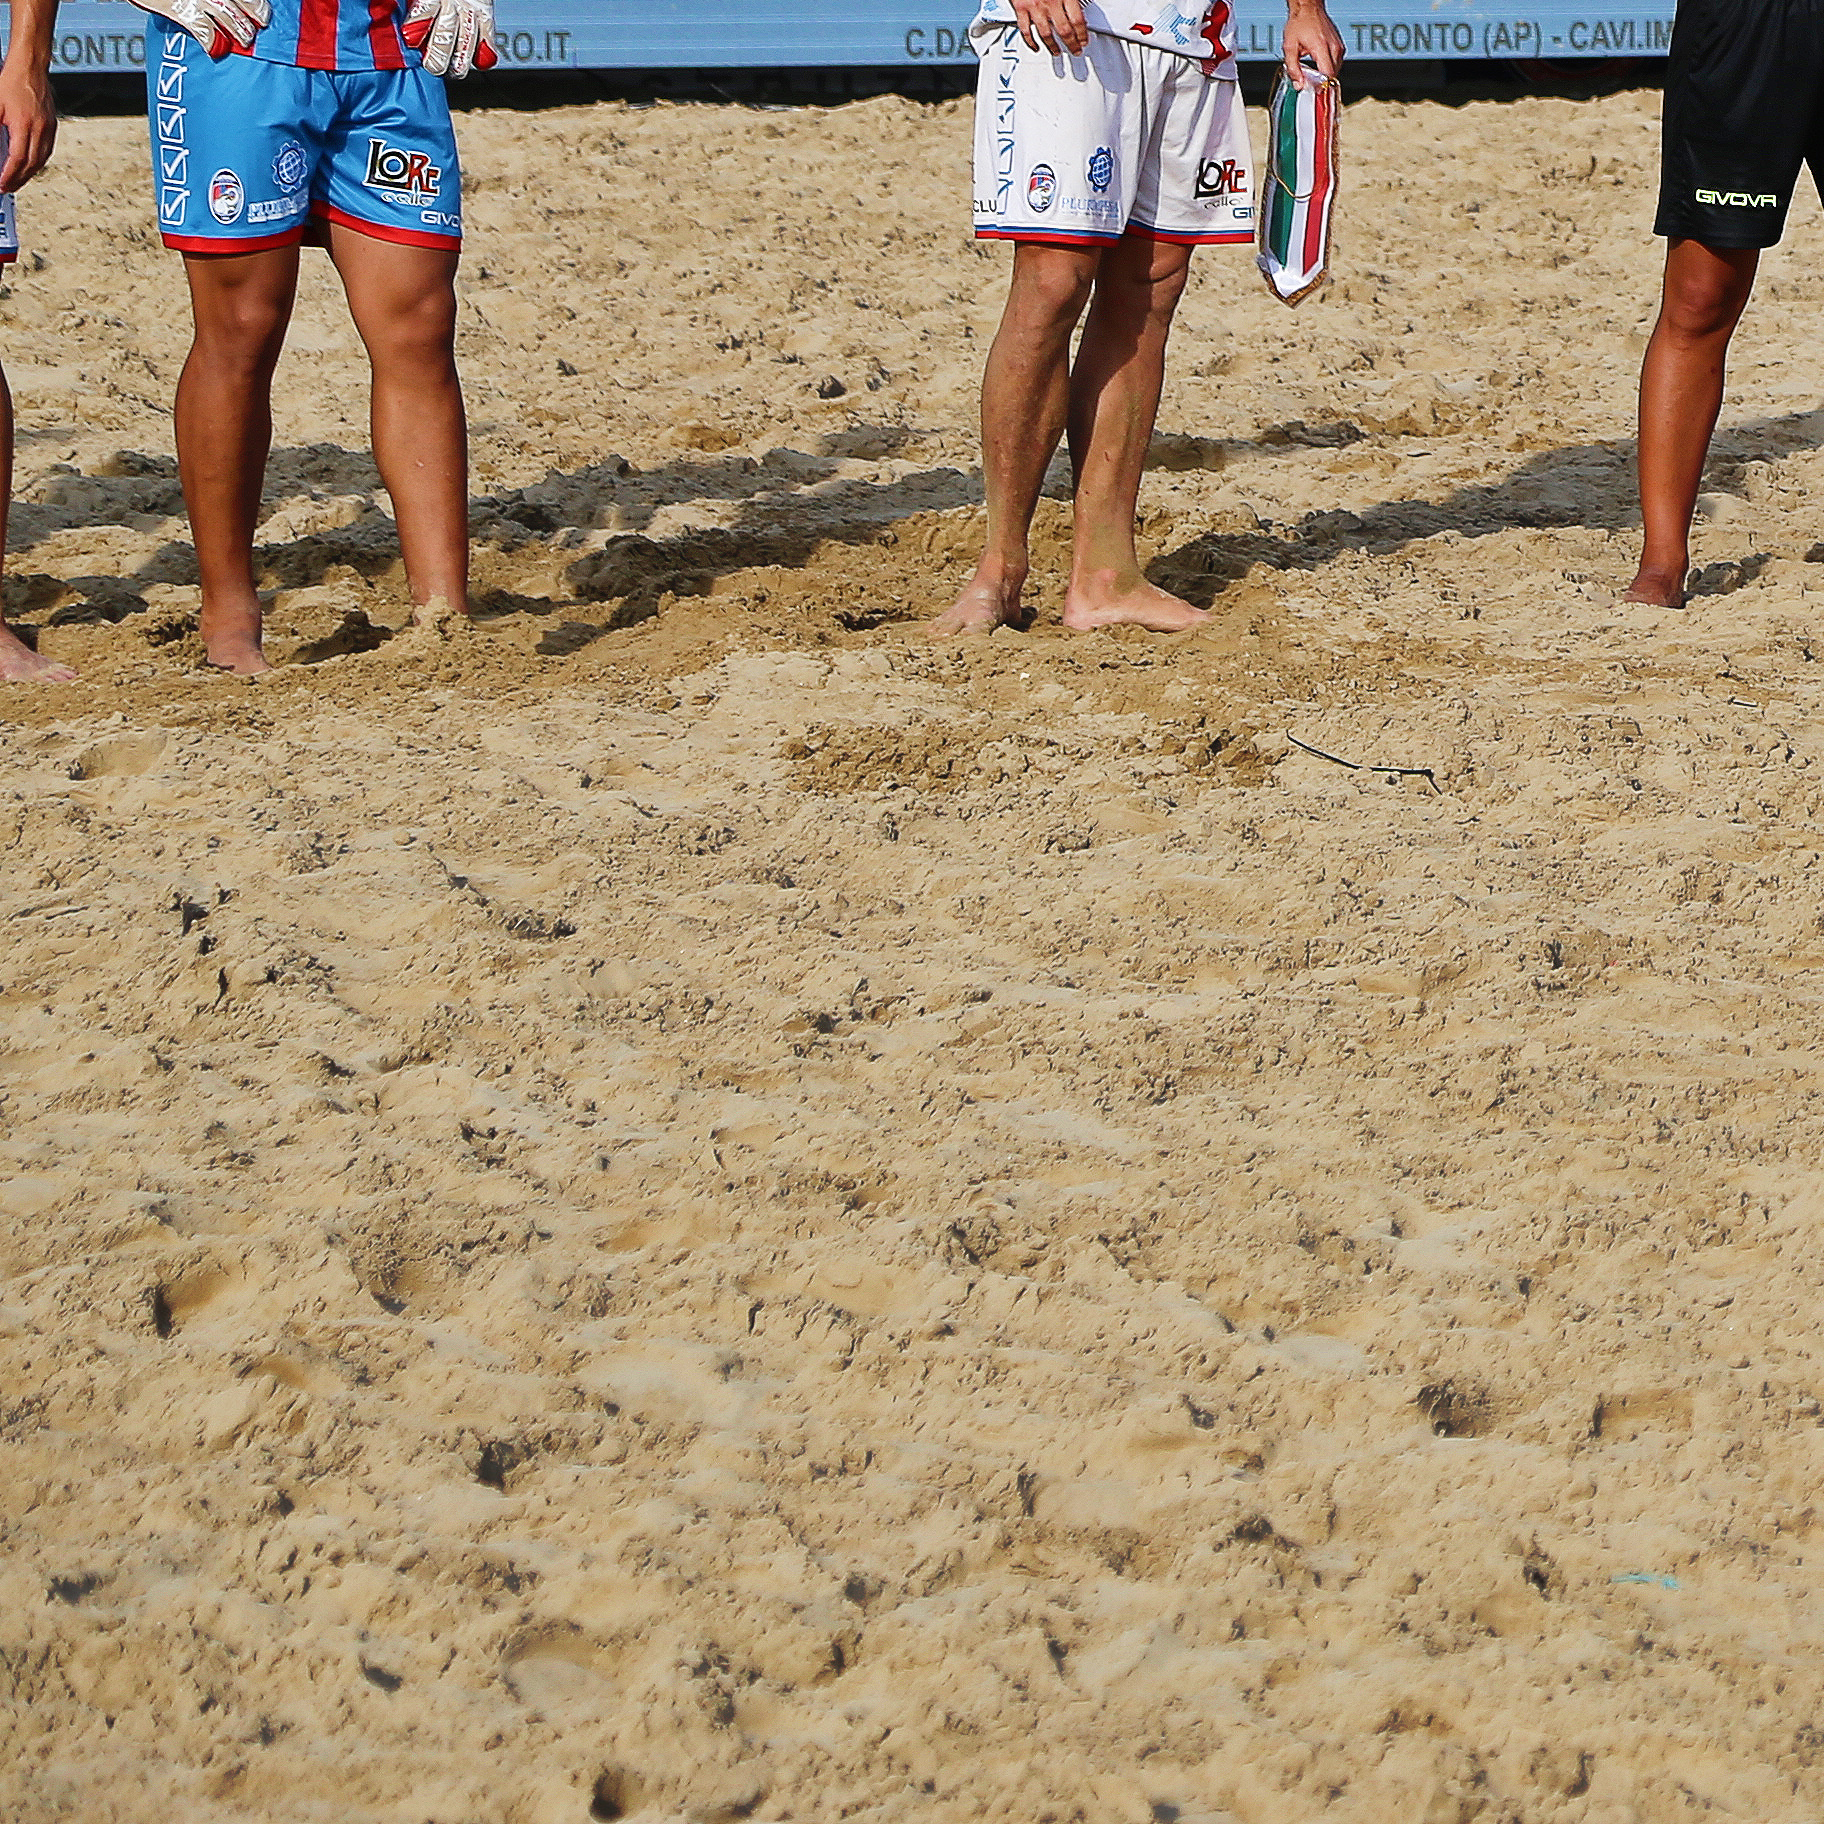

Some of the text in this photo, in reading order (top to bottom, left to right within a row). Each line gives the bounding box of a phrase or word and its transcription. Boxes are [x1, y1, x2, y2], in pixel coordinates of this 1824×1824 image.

[48, 33, 145, 65] RONTO
[1352, 23, 1471, 53] TRONTO
[1485, 21, 1542, 58] (AP)
[1569, 21, 1676, 51] CAVI.IM
[1696, 189, 1776, 208] GIVOVA
[420, 210, 462, 228] GIVO
